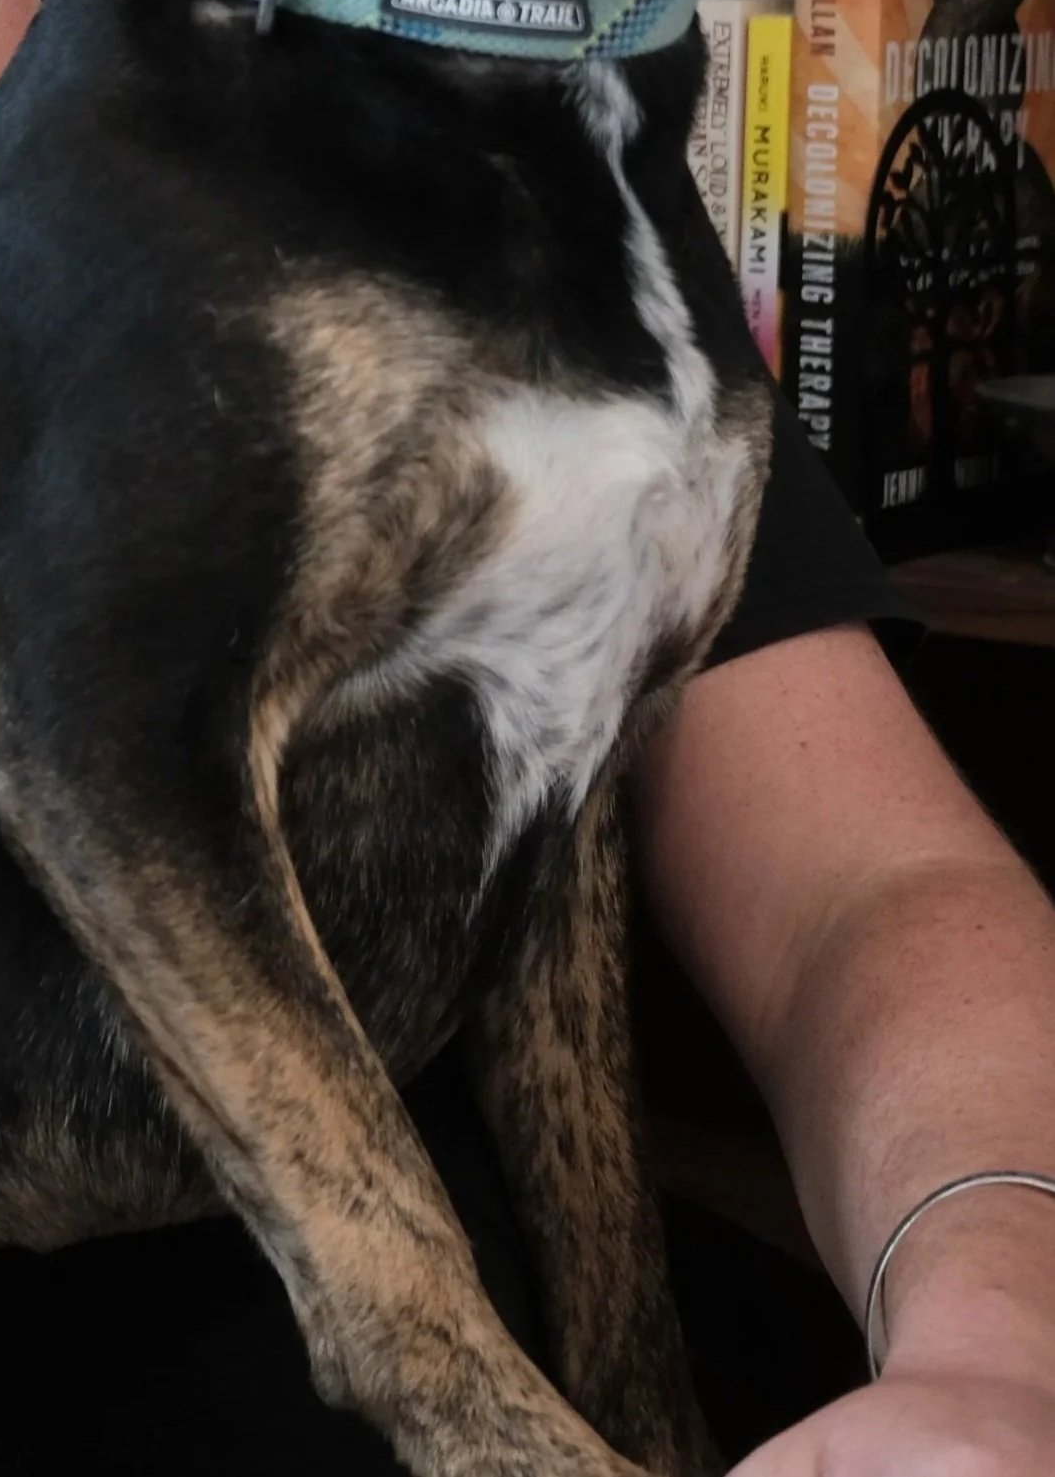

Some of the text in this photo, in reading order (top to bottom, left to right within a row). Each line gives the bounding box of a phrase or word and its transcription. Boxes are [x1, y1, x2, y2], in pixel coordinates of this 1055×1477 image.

[518, 2, 577, 28] TRAIL
[711, 20, 732, 142] EXTREMELY
[709, 142, 728, 197] LOUD
[748, 125, 771, 275] MURAKAMI
[798, 83, 840, 452] DECOLONIZING THERAPY
